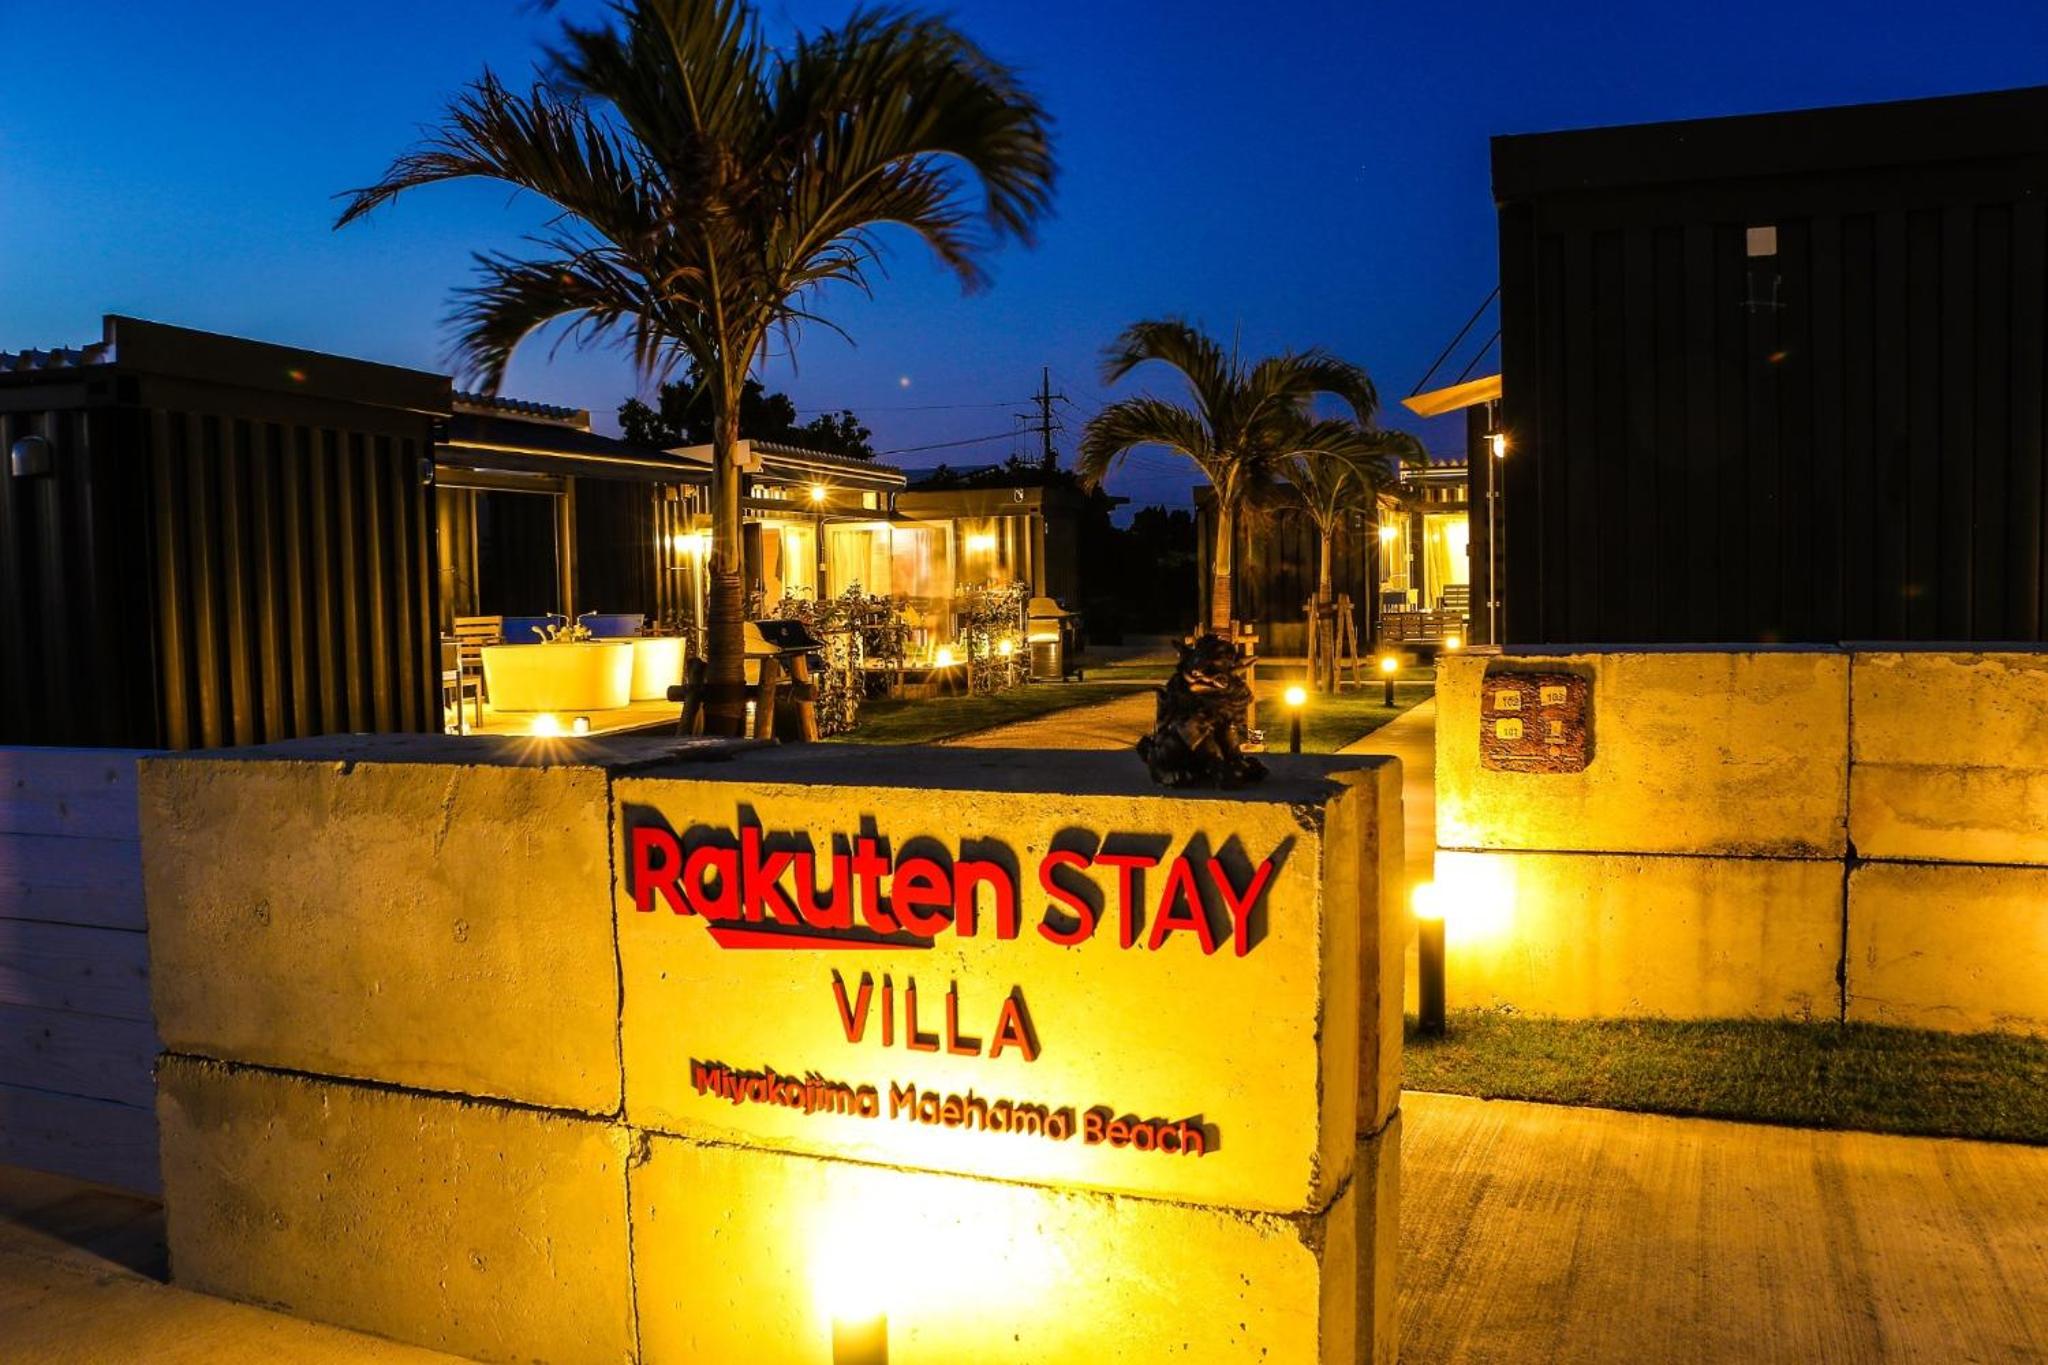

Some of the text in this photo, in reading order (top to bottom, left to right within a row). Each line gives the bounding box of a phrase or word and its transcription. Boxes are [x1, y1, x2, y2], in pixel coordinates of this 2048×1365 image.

[632, 826, 1275, 957] Rakuten STAY
[832, 976, 1041, 1062] VILLA
[694, 1064, 1207, 1157] Miyakojima Maehama Beach
